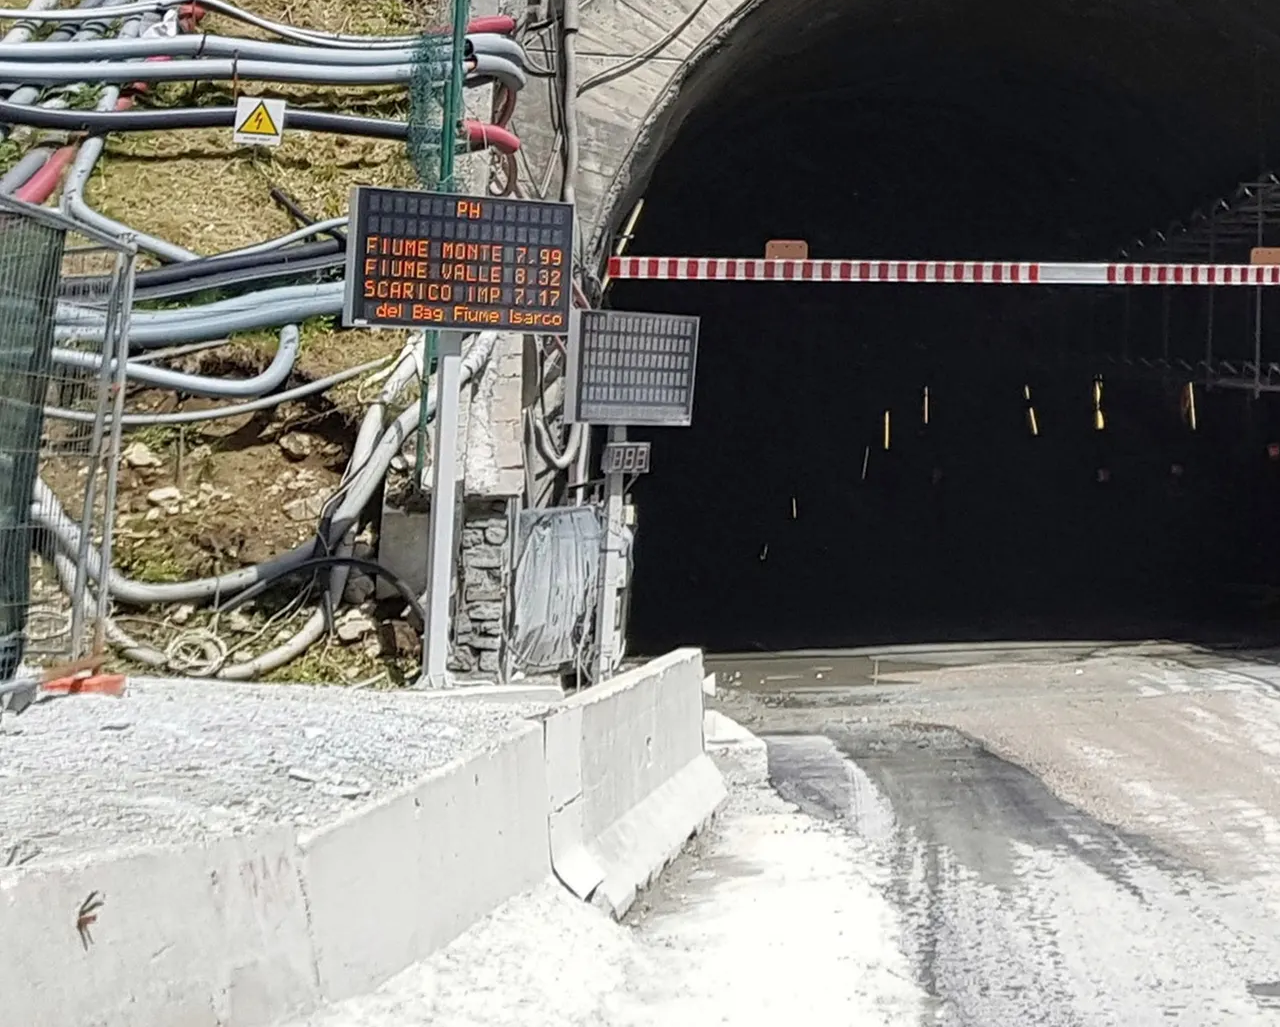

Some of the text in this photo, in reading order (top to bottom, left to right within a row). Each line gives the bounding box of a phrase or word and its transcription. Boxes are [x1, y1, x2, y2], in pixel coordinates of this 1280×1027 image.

[457, 201, 481, 218] PH
[366, 237, 429, 258] FIUME
[442, 242, 503, 263] MONTE
[364, 258, 427, 279] FIUME
[442, 263, 502, 283] VALLE
[364, 280, 451, 301] SCARICO
[468, 286, 500, 304] IMP
[375, 302, 562, 326] del Bag Fiume Isarco
